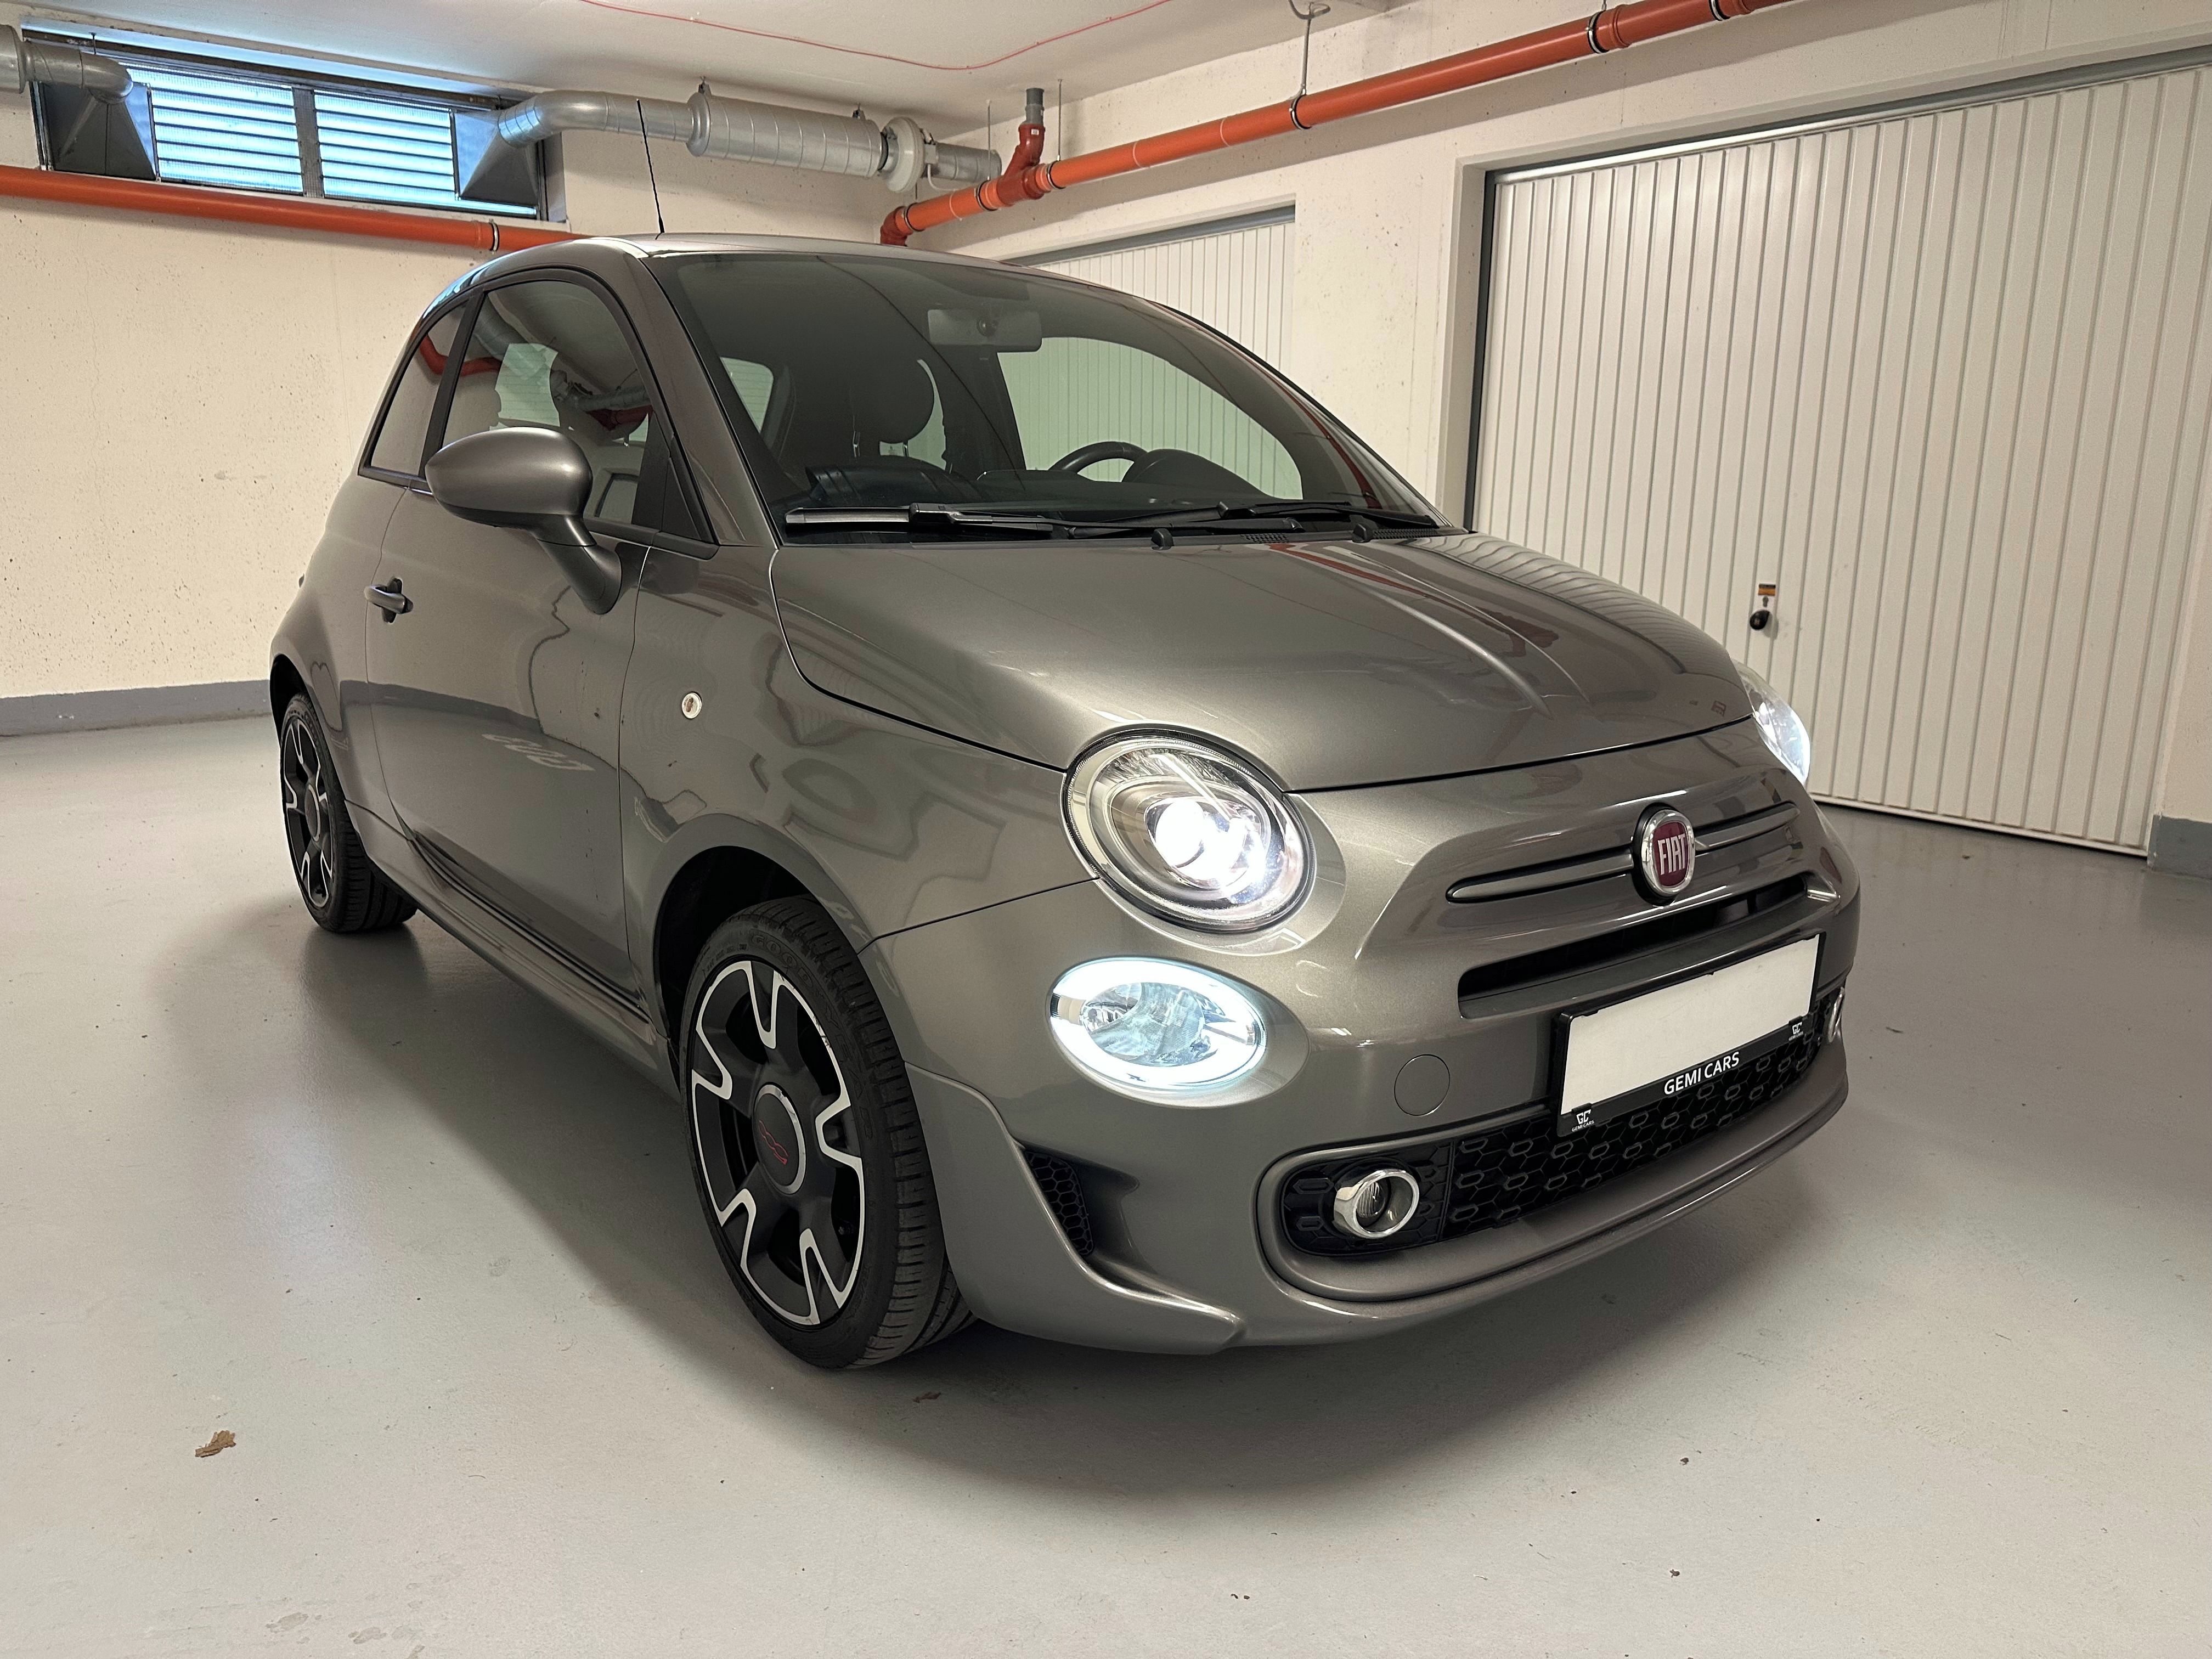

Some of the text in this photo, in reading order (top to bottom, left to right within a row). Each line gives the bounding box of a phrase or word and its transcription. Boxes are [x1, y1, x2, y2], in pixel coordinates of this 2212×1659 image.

[1657, 833, 1686, 876] FIAT
[750, 930, 874, 1141] GOODYEAR
[1664, 1051, 1740, 1095] GEMI CARS
